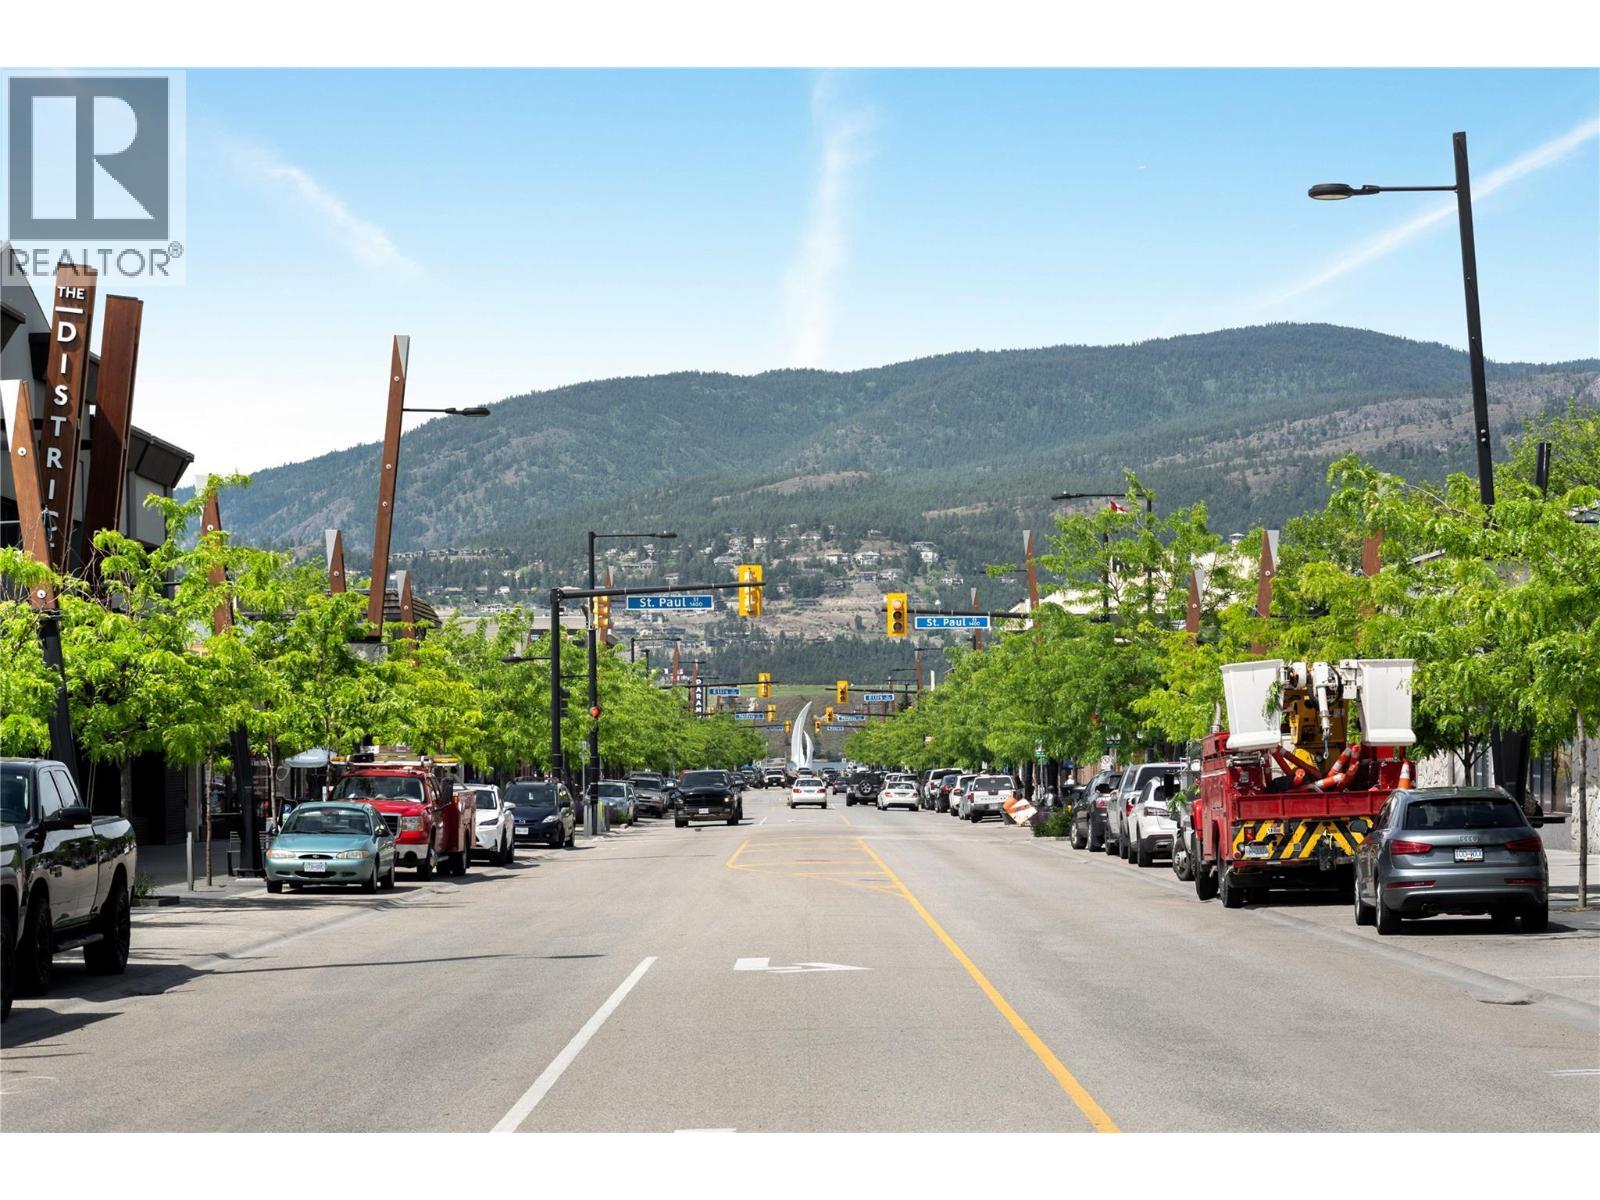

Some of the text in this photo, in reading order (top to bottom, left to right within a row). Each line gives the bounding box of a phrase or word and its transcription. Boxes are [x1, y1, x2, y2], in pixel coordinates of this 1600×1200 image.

[57, 285, 86, 300] THE
[46, 320, 77, 548] DISTRIC
[640, 597, 687, 608] St. Paul
[926, 618, 966, 627] St. Paul
